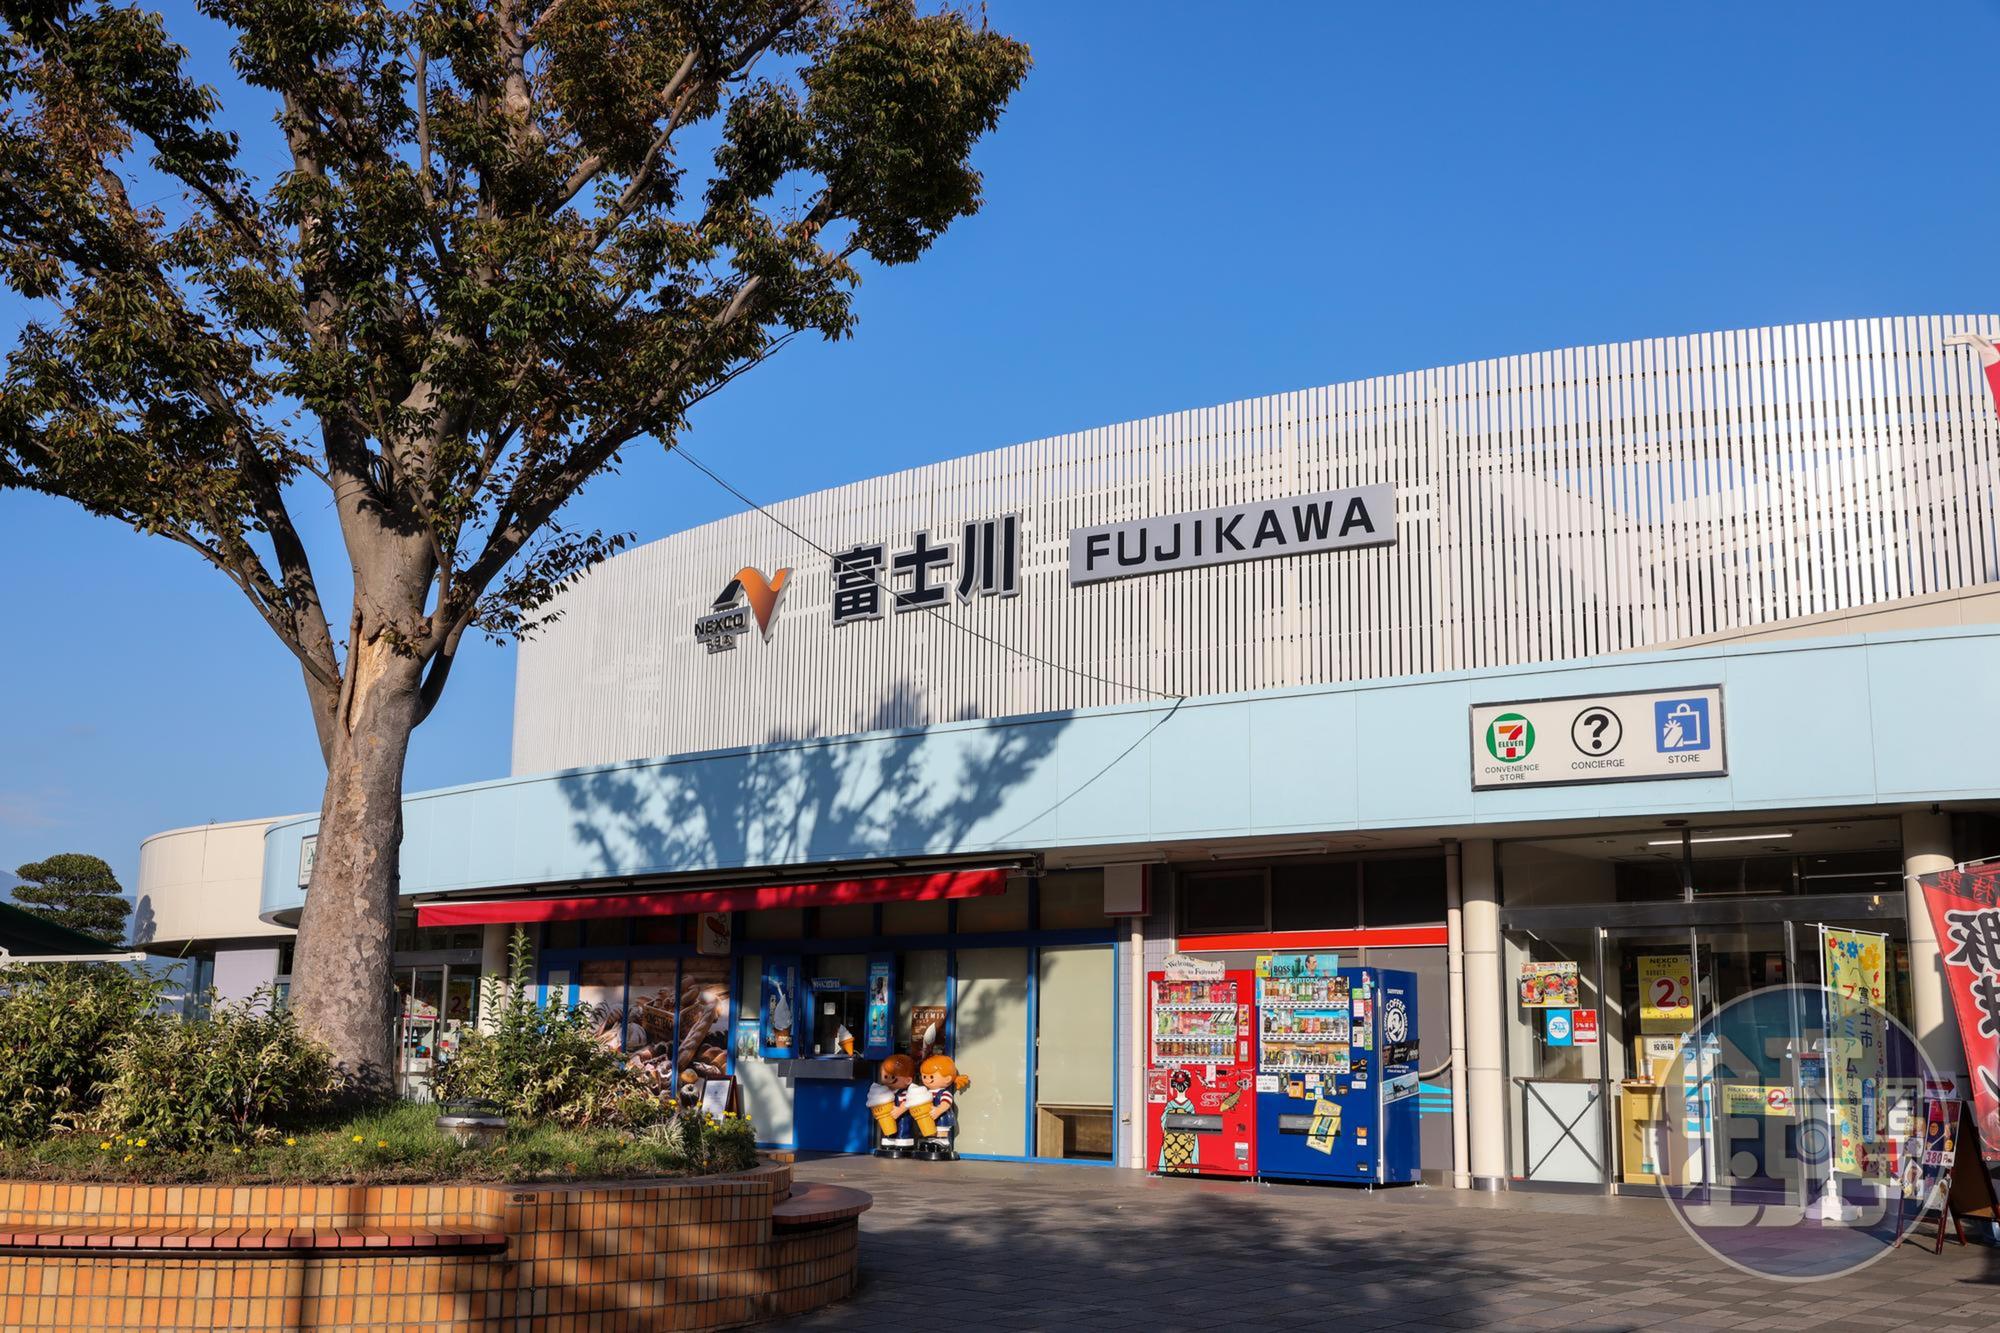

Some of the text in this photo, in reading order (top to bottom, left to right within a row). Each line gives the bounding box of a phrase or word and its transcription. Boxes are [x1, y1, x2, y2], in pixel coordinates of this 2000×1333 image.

[1085, 496, 1375, 572] FUJIKAWA
[831, 513, 1021, 625] 富士川
[694, 613, 744, 637] NEXCO
[1571, 758, 1625, 770] CONCIERGE
[1668, 754, 1700, 764] STORE
[1485, 764, 1540, 774] CONVENIENCE
[1656, 979, 1677, 1008] 2
[913, 1011, 946, 1020] CREMIA
